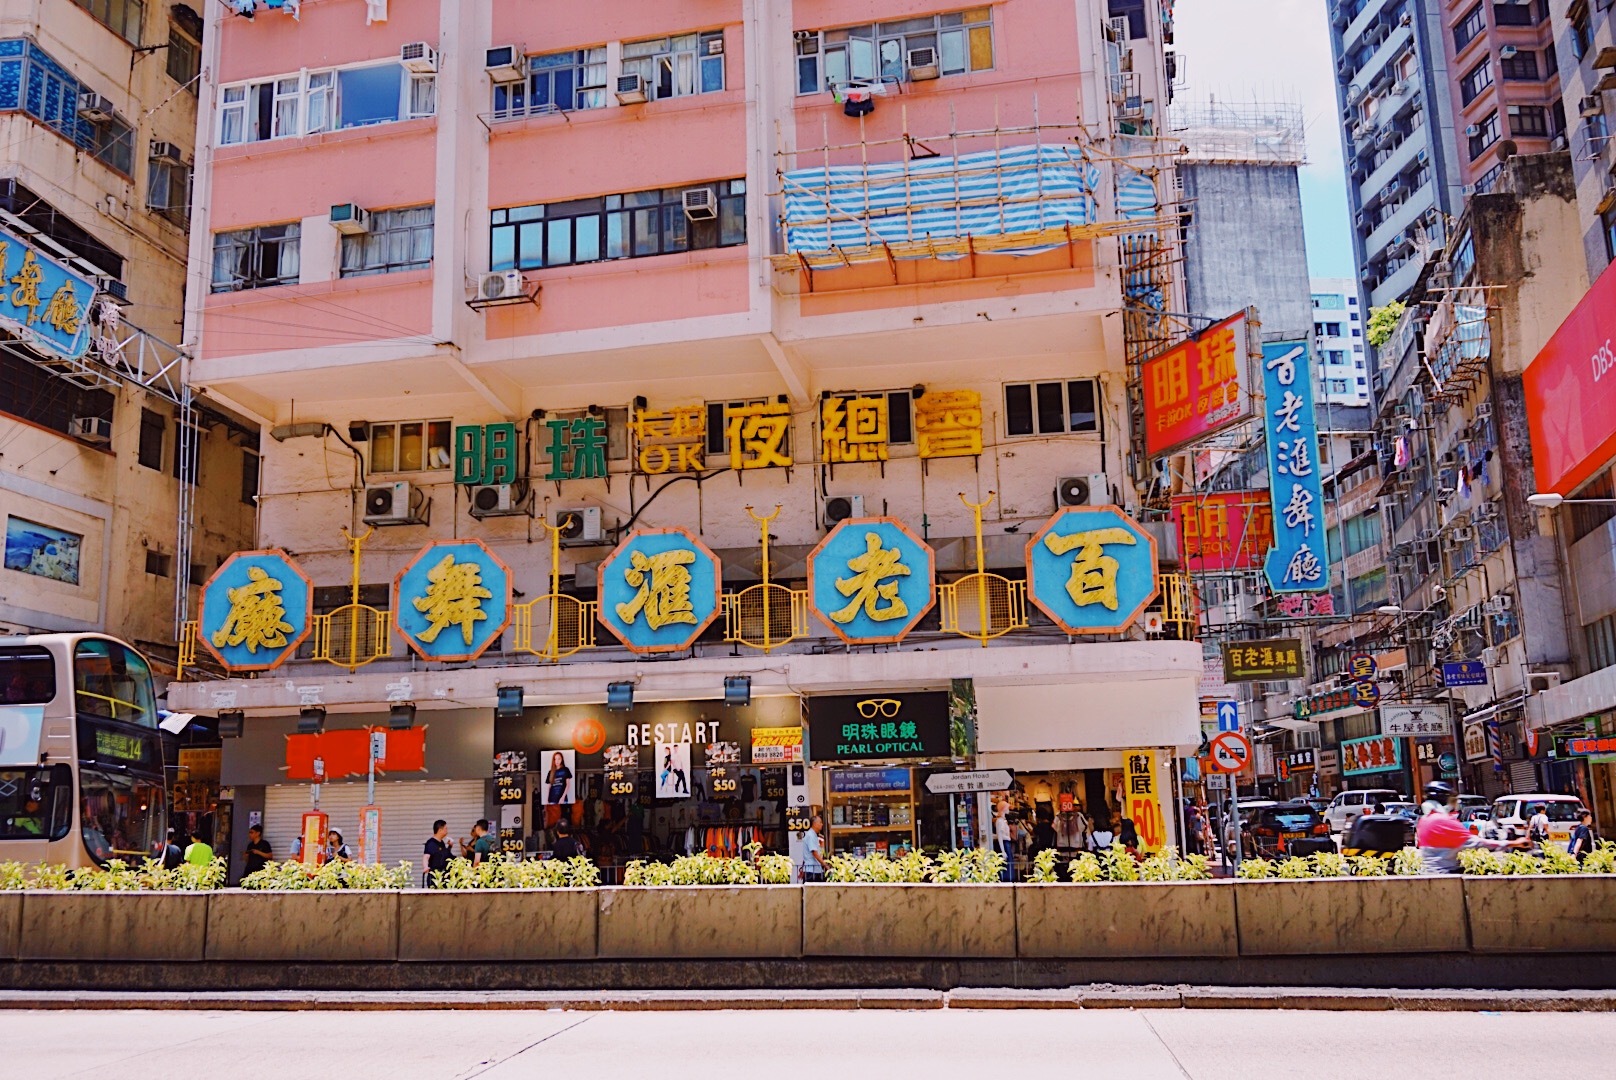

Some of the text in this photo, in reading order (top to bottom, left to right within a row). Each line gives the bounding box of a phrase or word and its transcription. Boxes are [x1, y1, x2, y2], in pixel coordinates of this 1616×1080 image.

[1592, 339, 1613, 382] DBS
[1153, 328, 1237, 408] 明珠
[455, 420, 607, 484] 明珠
[639, 444, 705, 475] OK
[627, 721, 720, 746] RESTART
[842, 721, 918, 740] 明珠眼鏡
[130, 738, 141, 759] 14
[837, 742, 924, 754] PEARL OPTICAL
[610, 756, 637, 766] SALE
[711, 753, 738, 763] SALE
[1129, 755, 1152, 794] 徹底
[611, 782, 633, 794] $50
[713, 779, 736, 791] $50
[957, 782, 984, 790] 佐敦道
[500, 788, 522, 799] $50
[1062, 801, 1073, 810] 50
[788, 818, 811, 830] $50
[502, 839, 524, 851] $50
